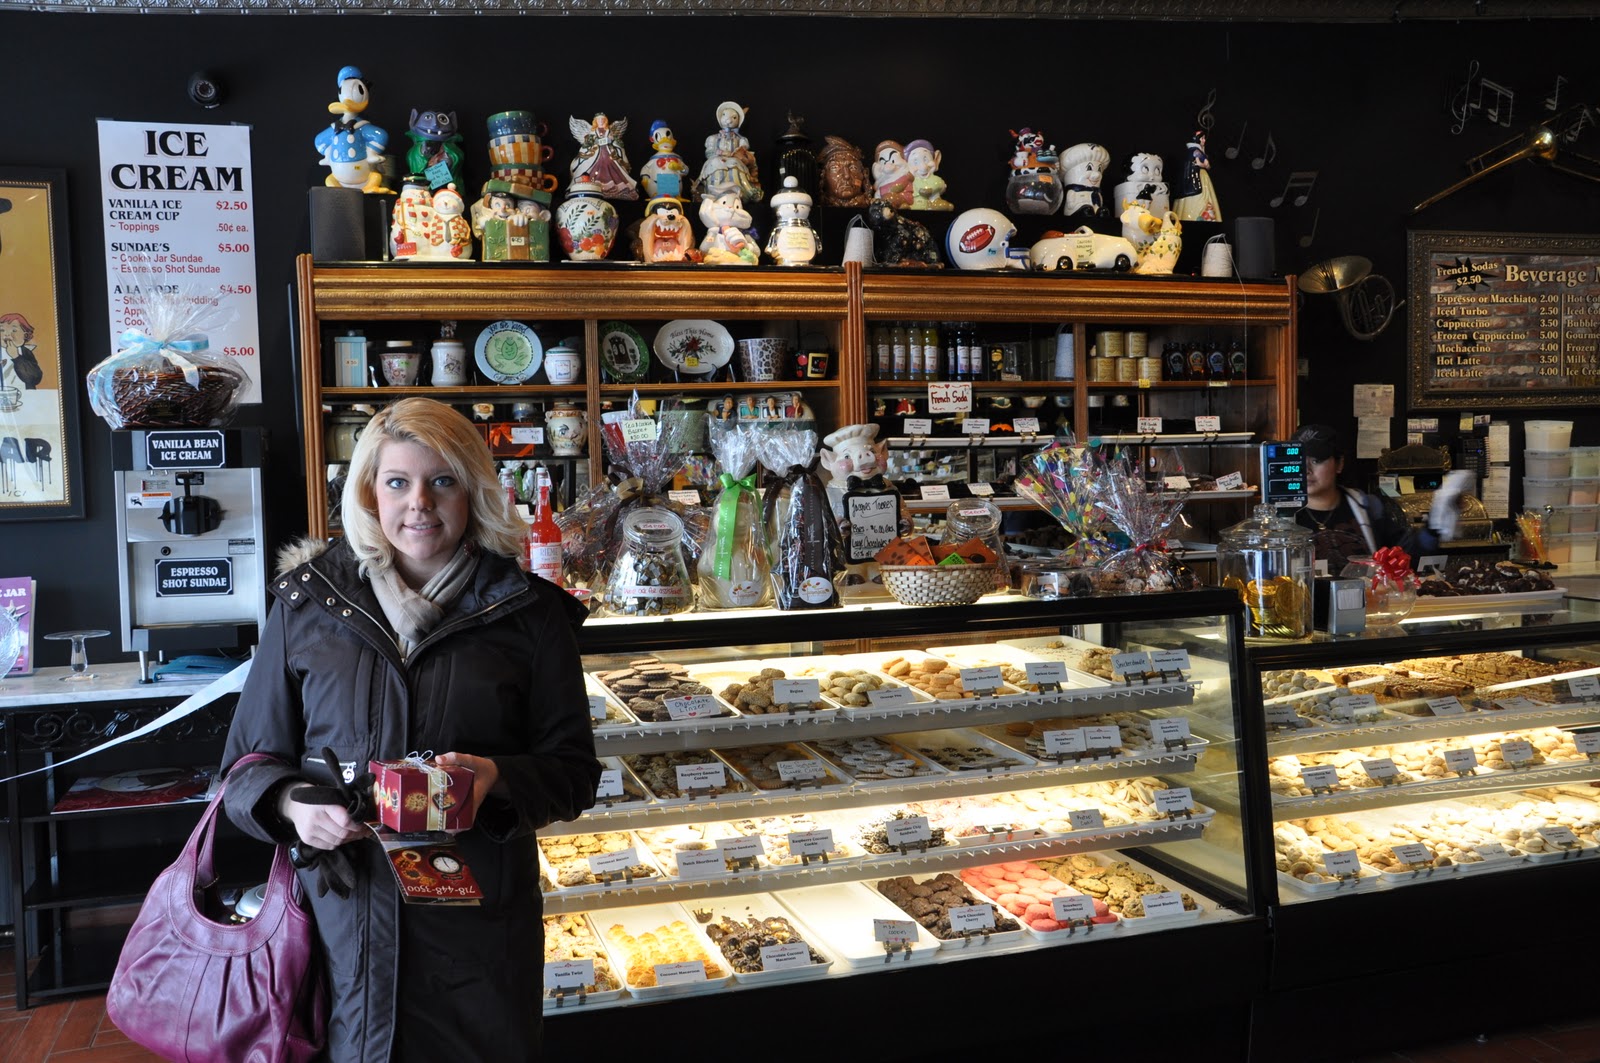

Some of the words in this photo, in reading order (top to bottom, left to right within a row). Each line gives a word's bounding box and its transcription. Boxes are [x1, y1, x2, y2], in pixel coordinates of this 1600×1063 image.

[144, 130, 209, 157] ICE
[110, 164, 244, 191] CREAM
[108, 199, 159, 209] VANILLA
[162, 200, 182, 209] ICE
[216, 201, 247, 211] $2.50
[109, 210, 152, 220] CREAM
[156, 211, 180, 220] CUP
[118, 222, 160, 233] Toppings
[111, 243, 170, 252] SUNDAE'S
[218, 243, 250, 253] $5.00
[154, 254, 167, 262] Jar
[170, 254, 203, 263] Sundae
[165, 265, 186, 273] Shot
[188, 265, 220, 273] Sundae
[1436, 265, 1469, 277] French
[1471, 262, 1498, 272] Sodas
[1505, 264, 1587, 287] Beverage
[1456, 275, 1482, 286] $2.50
[114, 285, 122, 294] A
[126, 285, 140, 294] LA
[220, 284, 251, 294] $4.50
[1437, 294, 1476, 305] Espresso
[1490, 294, 1537, 303] Macchiato
[1540, 295, 1559, 303] 2.00
[1567, 295, 1583, 303] Hot
[1437, 307, 1456, 316] Iced
[1460, 307, 1488, 316] Turbo
[1540, 307, 1558, 315] 2.50
[1567, 307, 1584, 315] Iced
[1436, 319, 1490, 330] Cappuccino
[1540, 319, 1558, 327] 3.50
[670, 331, 684, 339] Bless
[684, 328, 698, 336] This
[1437, 332, 1468, 340] Frozen
[1540, 331, 1558, 339] 5.00
[223, 347, 255, 356] $5.00
[1437, 344, 1491, 353] Mochaccino
[1539, 343, 1558, 351] 4.00
[1567, 343, 1595, 351] Frozen
[1437, 357, 1453, 365] Hot
[1457, 357, 1481, 365] Latte
[1540, 355, 1558, 363] 3.50
[1566, 355, 1587, 363] Milk
[1437, 369, 1456, 377] Iced
[1460, 369, 1483, 377] Latte
[1539, 367, 1558, 376] 4.00
[1566, 368, 1579, 376] Ice
[931, 391, 951, 405] French
[952, 390, 968, 402] Soda
[152, 439, 192, 449] VANILLA
[194, 439, 219, 448] BEAN
[161, 452, 176, 461] ICE
[178, 451, 212, 460] CREAM
[171, 567, 218, 577] ESPRESSO
[162, 579, 187, 588] SHOT
[190, 577, 227, 587] SUNDAE
[4, 588, 26, 597] JAR
[1116, 659, 1145, 668] Snickerdoodle
[674, 698, 710, 708] Chocolate
[679, 704, 706, 713] Linzer
[408, 885, 476, 896] 718-448-3500
